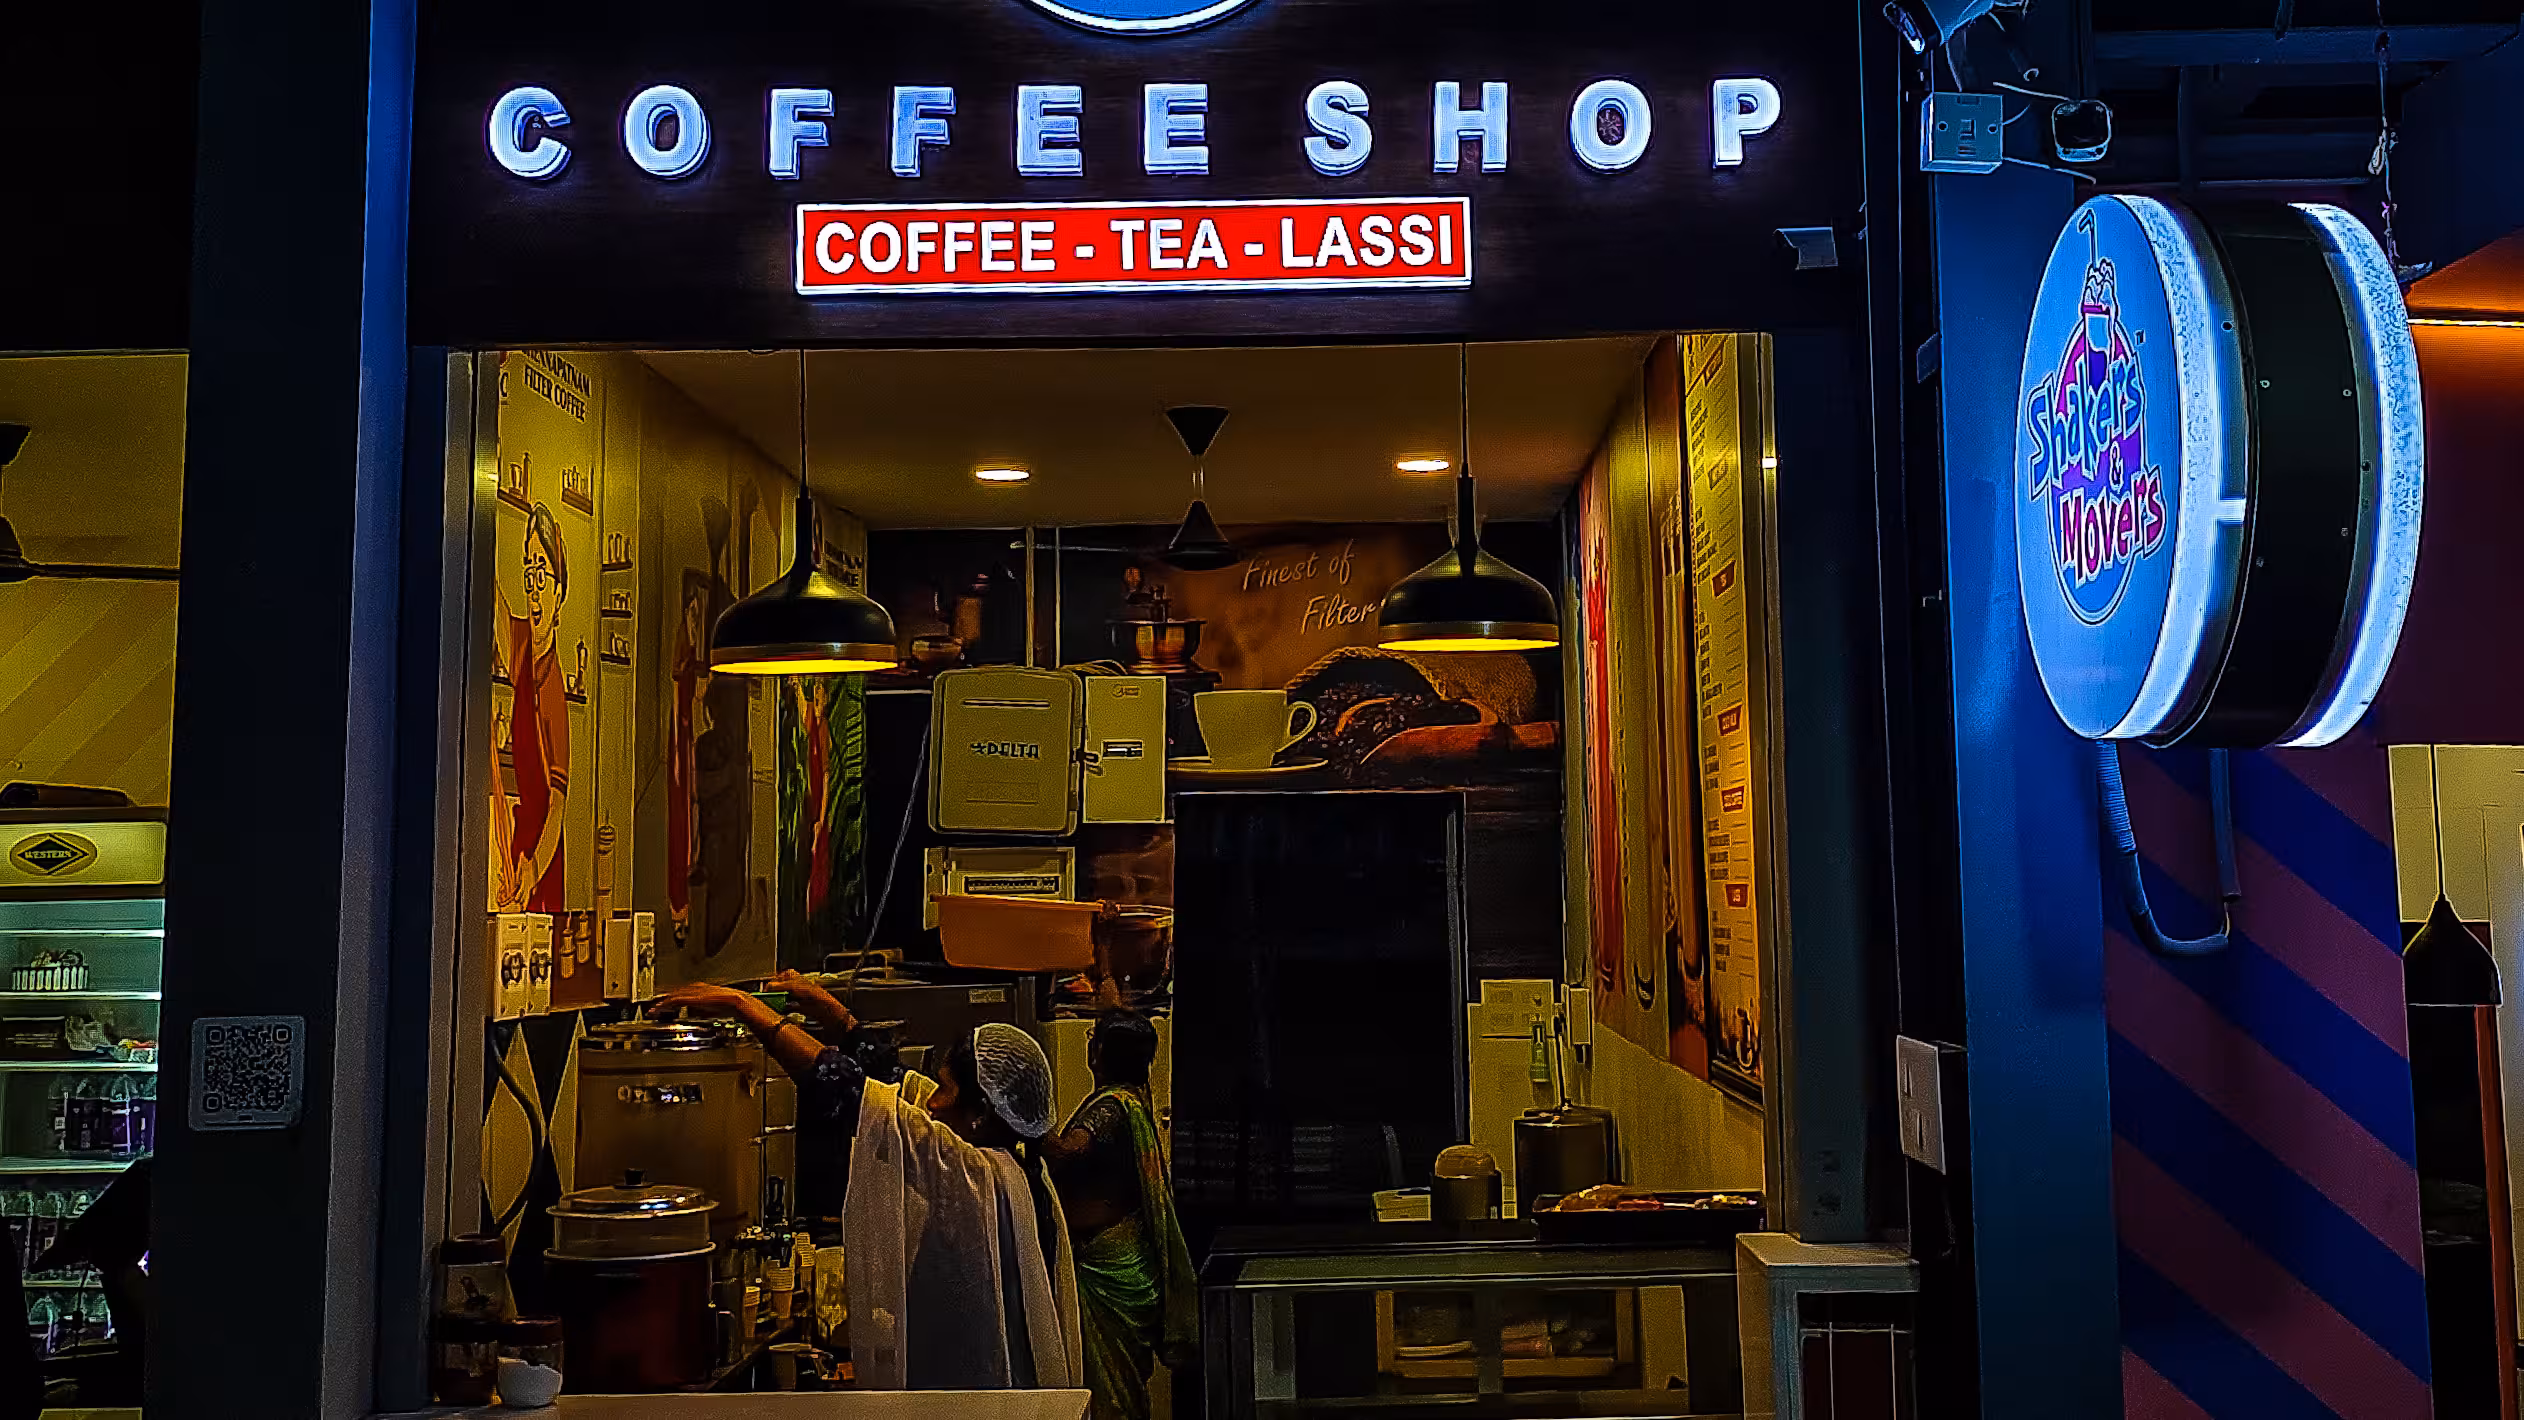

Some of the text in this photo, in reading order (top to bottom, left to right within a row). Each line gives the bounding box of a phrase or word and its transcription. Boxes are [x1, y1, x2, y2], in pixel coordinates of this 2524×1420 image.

[490, 78, 1779, 180] COFFEE SHOP
[815, 220, 1056, 275] COFFEE
[1109, 218, 1229, 270] TEA
[1281, 213, 1453, 268] LASSI
[524, 363, 553, 403] FILTER
[554, 384, 585, 422] COFFEE
[2029, 355, 2144, 499] Shakers
[2109, 440, 2124, 491] &
[1242, 539, 1355, 591] Finest of
[1301, 593, 1376, 635] Filter
